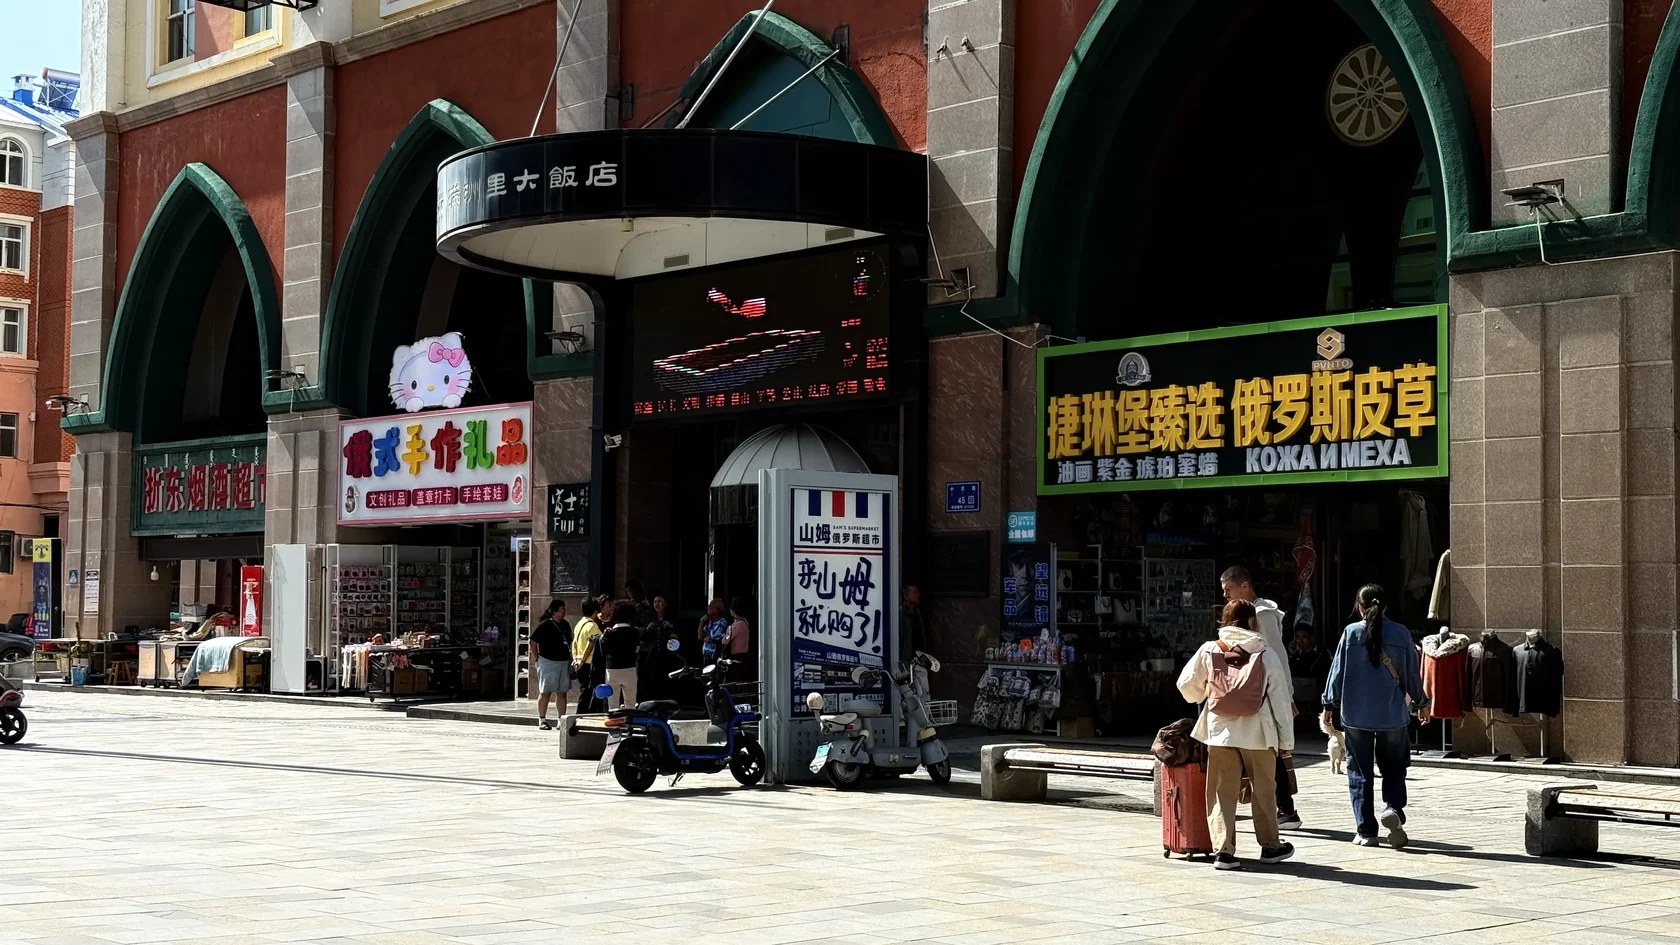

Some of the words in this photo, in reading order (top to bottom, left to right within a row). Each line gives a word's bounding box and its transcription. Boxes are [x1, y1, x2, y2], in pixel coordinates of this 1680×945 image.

[1047, 381, 1225, 460] 捷琳堡臻选
[1231, 362, 1436, 448] 俄罗斯皮草
[343, 417, 528, 478] 俄式手作礼品
[1246, 444, 1318, 473] КОЖА
[1320, 443, 1339, 469] И
[1341, 438, 1412, 468] МЕХА
[1057, 460, 1093, 484] 油画
[369, 492, 407, 507] 文创礼品
[416, 490, 452, 505] 盖章打卡
[462, 487, 502, 502] 手绘套娃
[799, 523, 831, 544] 山姆
[832, 532, 880, 545] 俄罗斯超市
[1004, 577, 1017, 615] 军品
[1035, 562, 1048, 622] 望远镜
